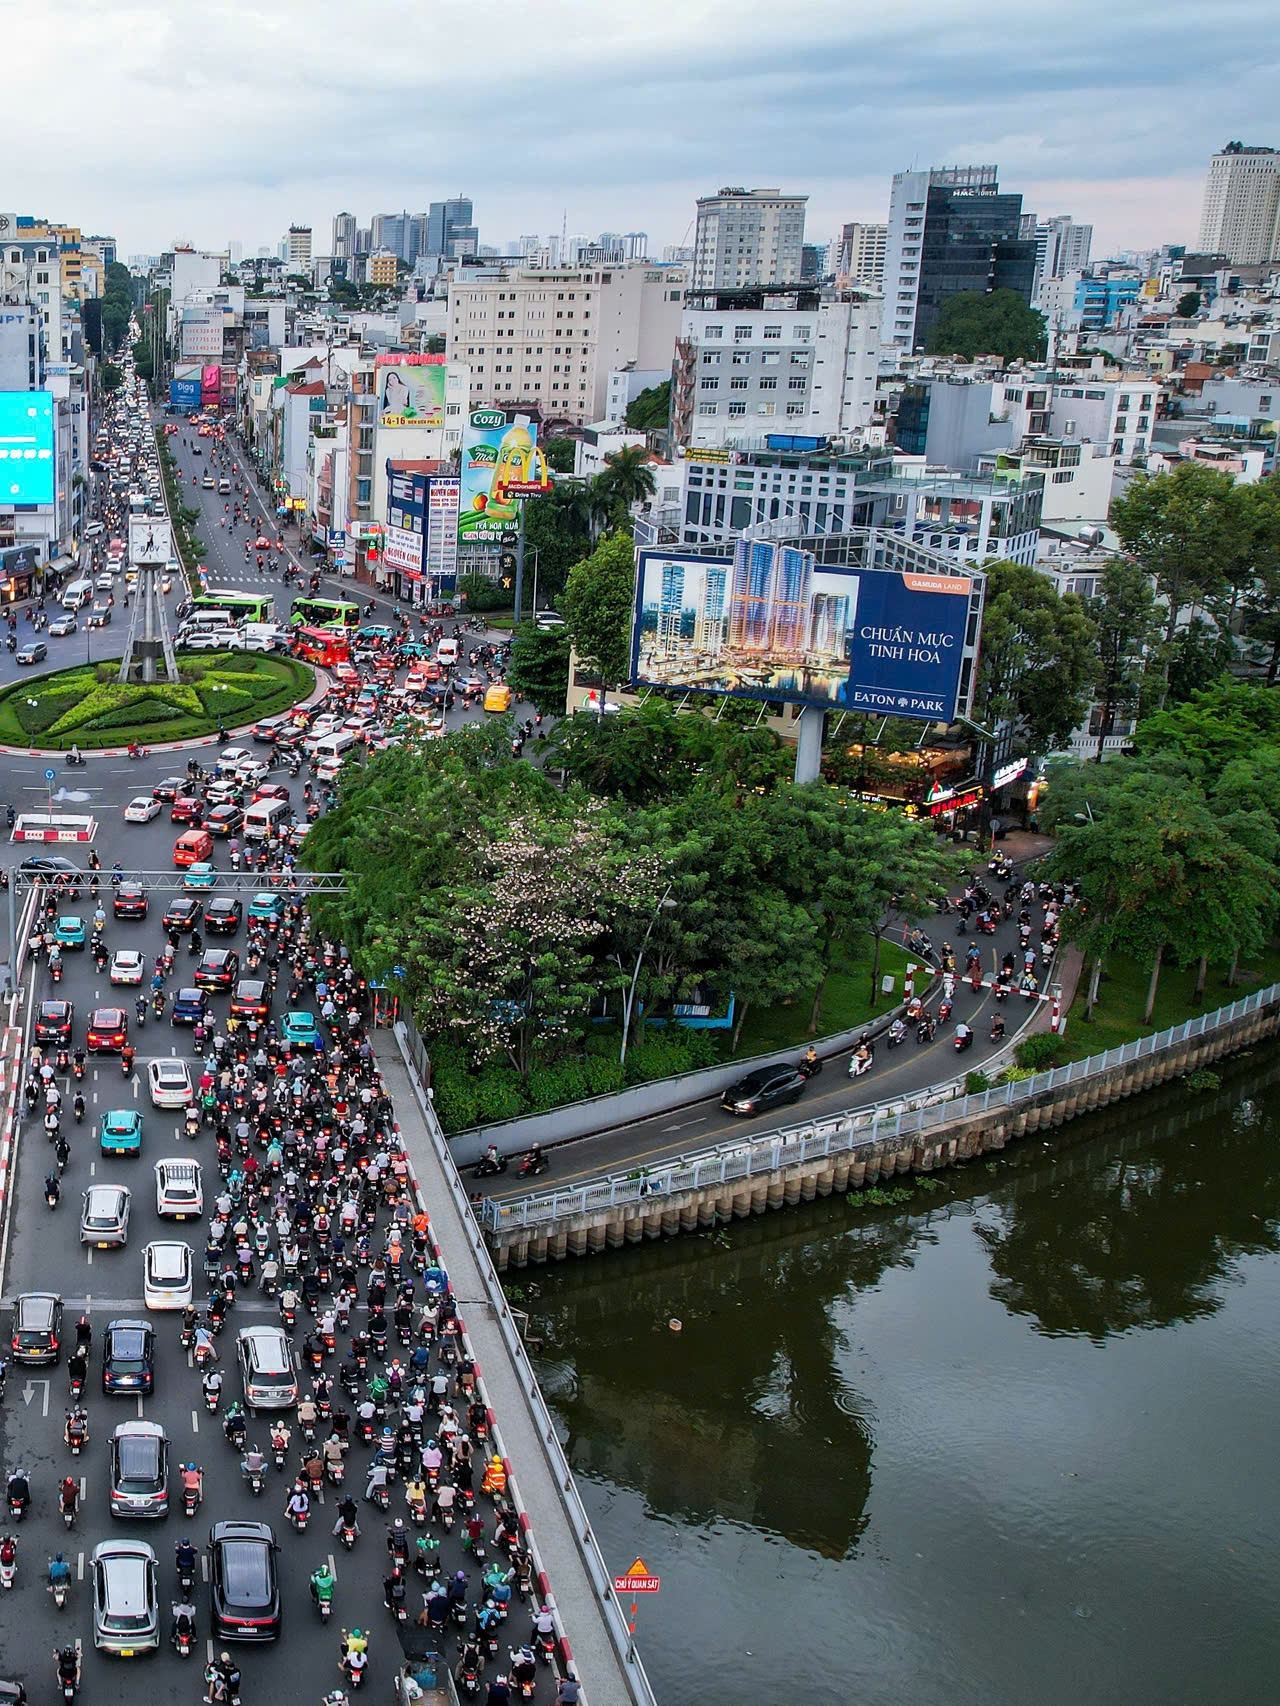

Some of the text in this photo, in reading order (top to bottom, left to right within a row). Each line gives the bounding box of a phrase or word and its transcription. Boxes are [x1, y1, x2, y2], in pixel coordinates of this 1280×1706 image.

[382, 417, 406, 425] 14-16
[473, 413, 502, 426] Cozy
[911, 579, 963, 590] GAMUDA LAND
[860, 625, 954, 649] CHUẨN MỰC
[869, 644, 941, 664] TINH HOA
[854, 691, 944, 712] EATON PARK
[615, 1578, 627, 1589] CHÚ
[631, 1580, 647, 1589] QUAN
[647, 1579, 658, 1589] SÁT
